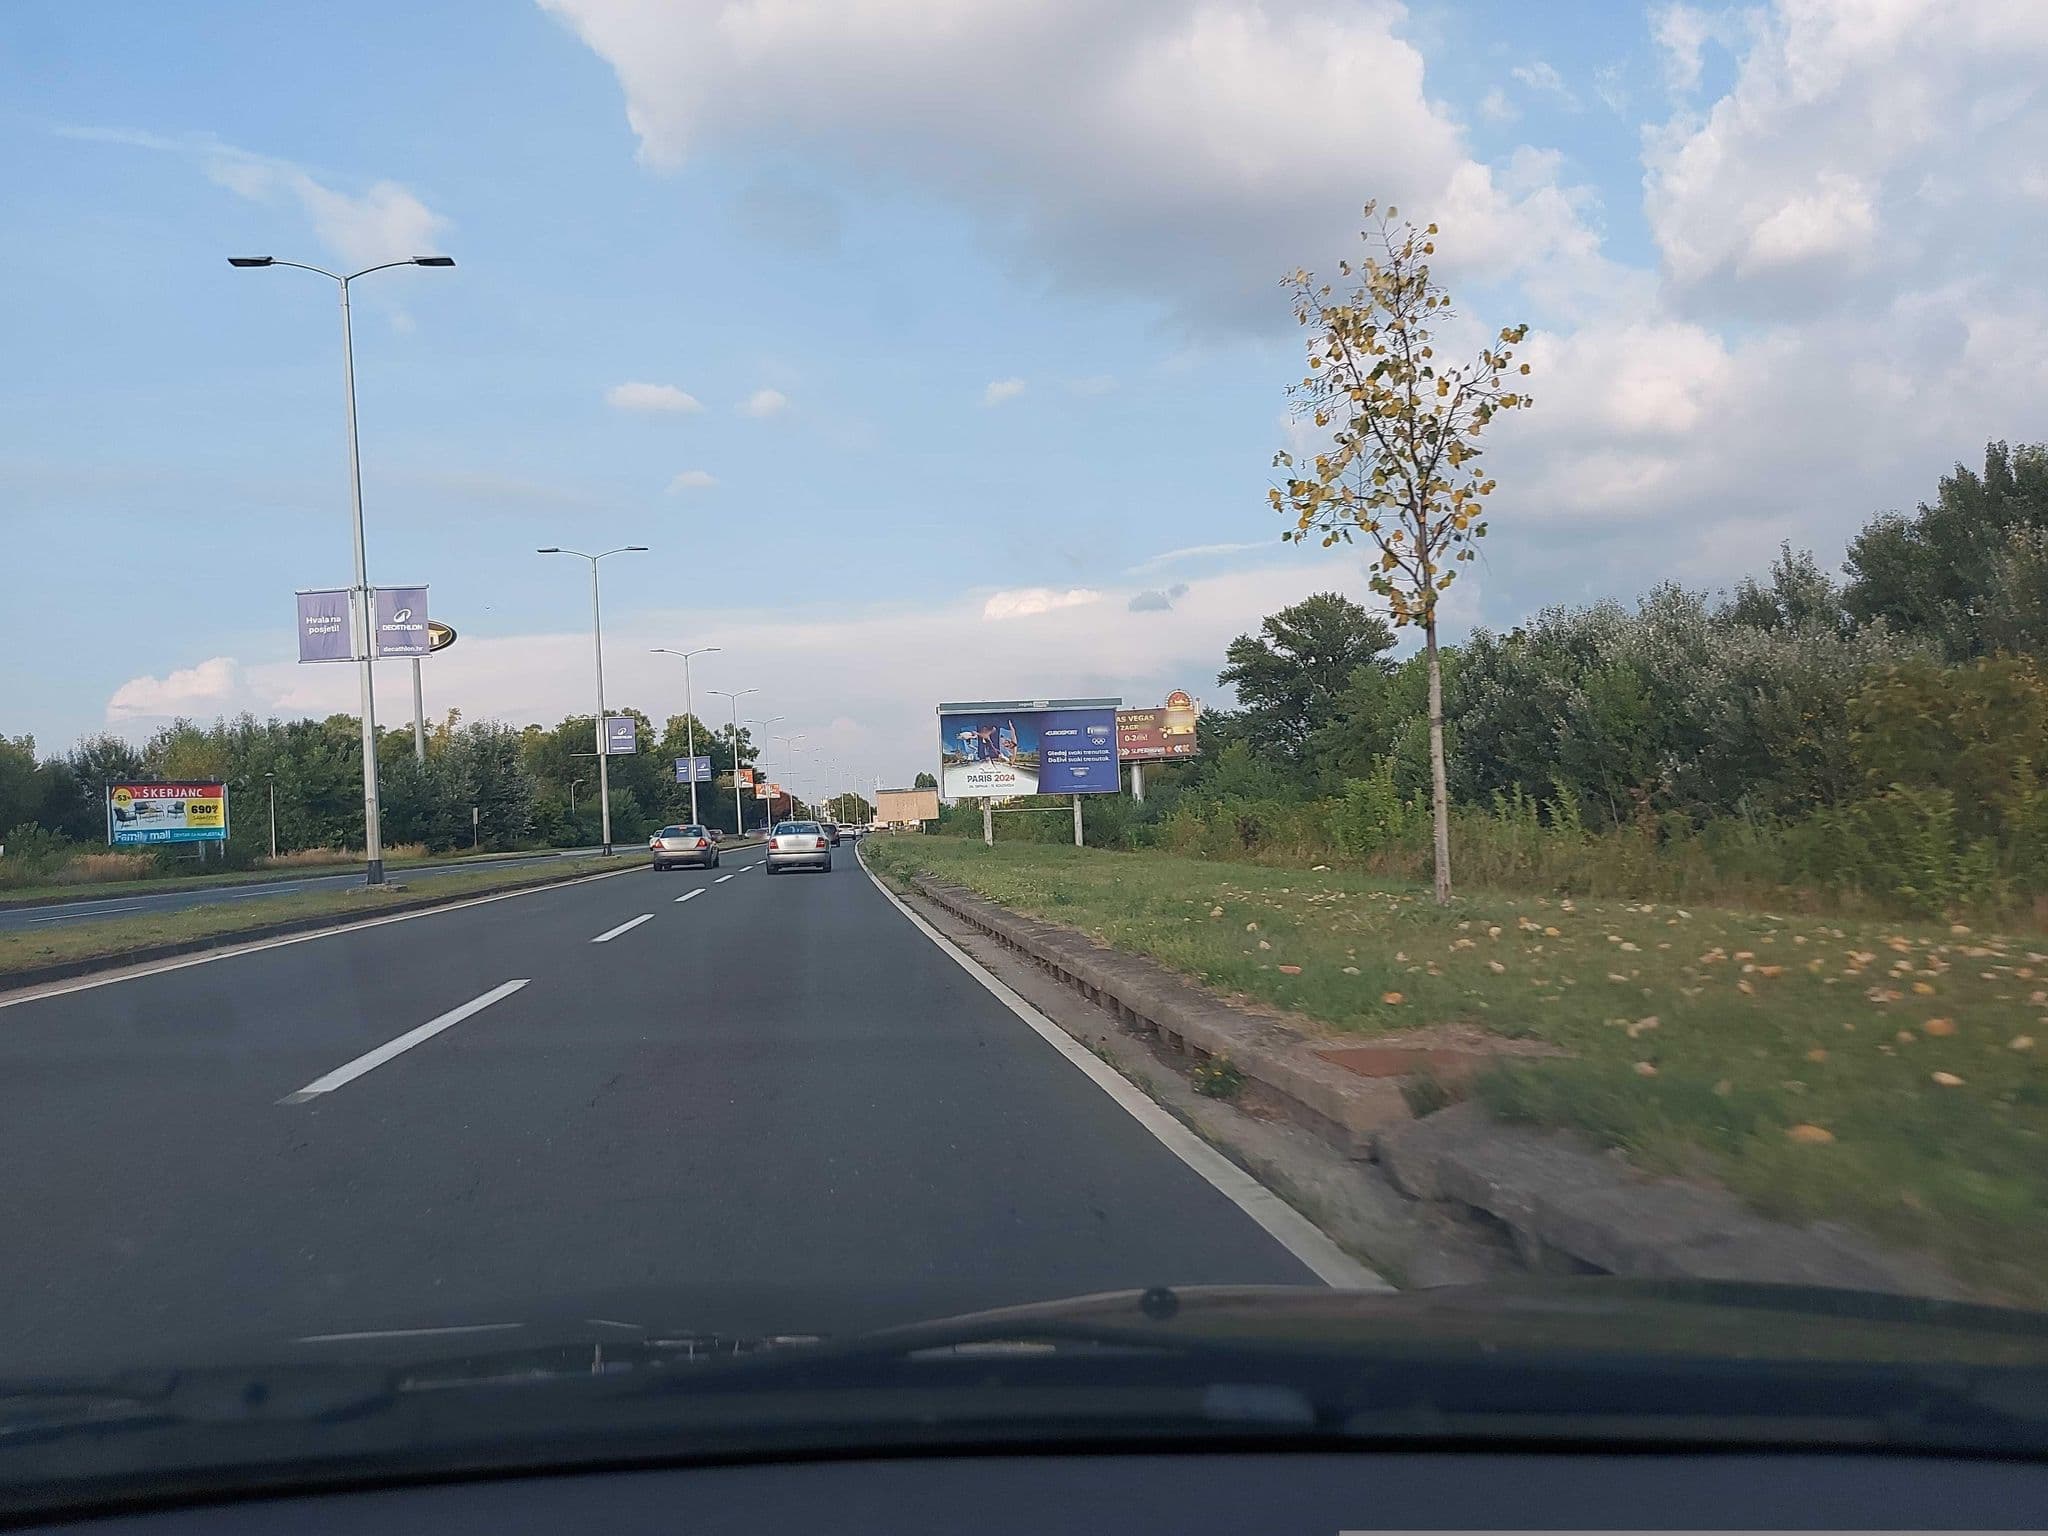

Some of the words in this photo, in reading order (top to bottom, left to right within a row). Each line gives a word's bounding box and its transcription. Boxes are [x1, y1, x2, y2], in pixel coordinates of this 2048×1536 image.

[305, 616, 329, 624] Hvala
[308, 624, 340, 635] posjeti!
[382, 623, 423, 631] DECATHLON
[1128, 714, 1155, 722] VEGAS
[967, 774, 992, 783] PARIS
[993, 773, 1016, 782] 2024
[143, 786, 203, 798] ŠKERJANC
[115, 832, 148, 843] Family
[150, 830, 170, 840] mall
